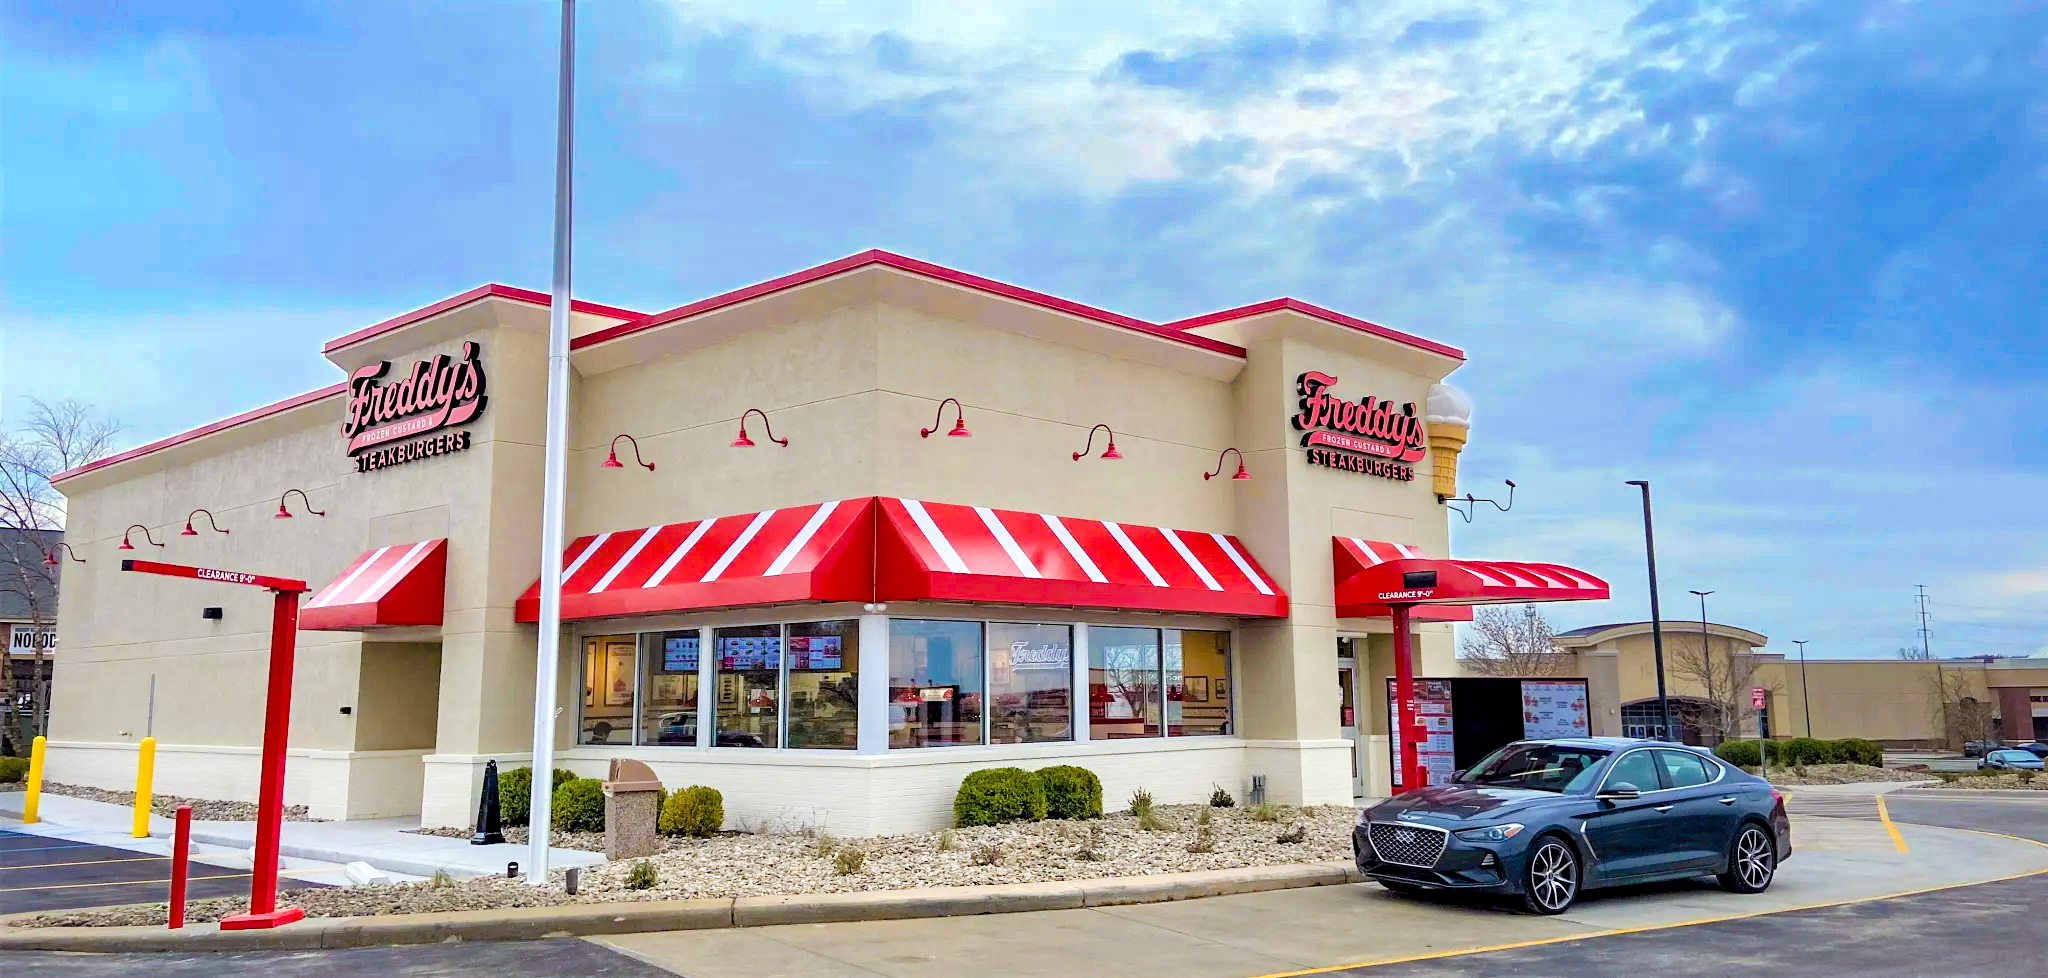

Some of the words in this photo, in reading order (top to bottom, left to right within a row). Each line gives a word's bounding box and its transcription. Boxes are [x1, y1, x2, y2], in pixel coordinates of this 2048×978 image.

[341, 341, 486, 442] Freddy's
[1294, 371, 1425, 450] Freddy's
[362, 429, 390, 443] FROZEN
[393, 419, 426, 436] CUSTARD
[428, 417, 433, 427] &
[1322, 434, 1351, 446] FROZEN
[1353, 441, 1385, 454] CUSTARD
[353, 431, 467, 473] STEAKBURGERS
[1311, 448, 1415, 481] STEAKBURGERS
[197, 568, 239, 582] CLEARANCE
[1378, 590, 1417, 599] CLEARANCE
